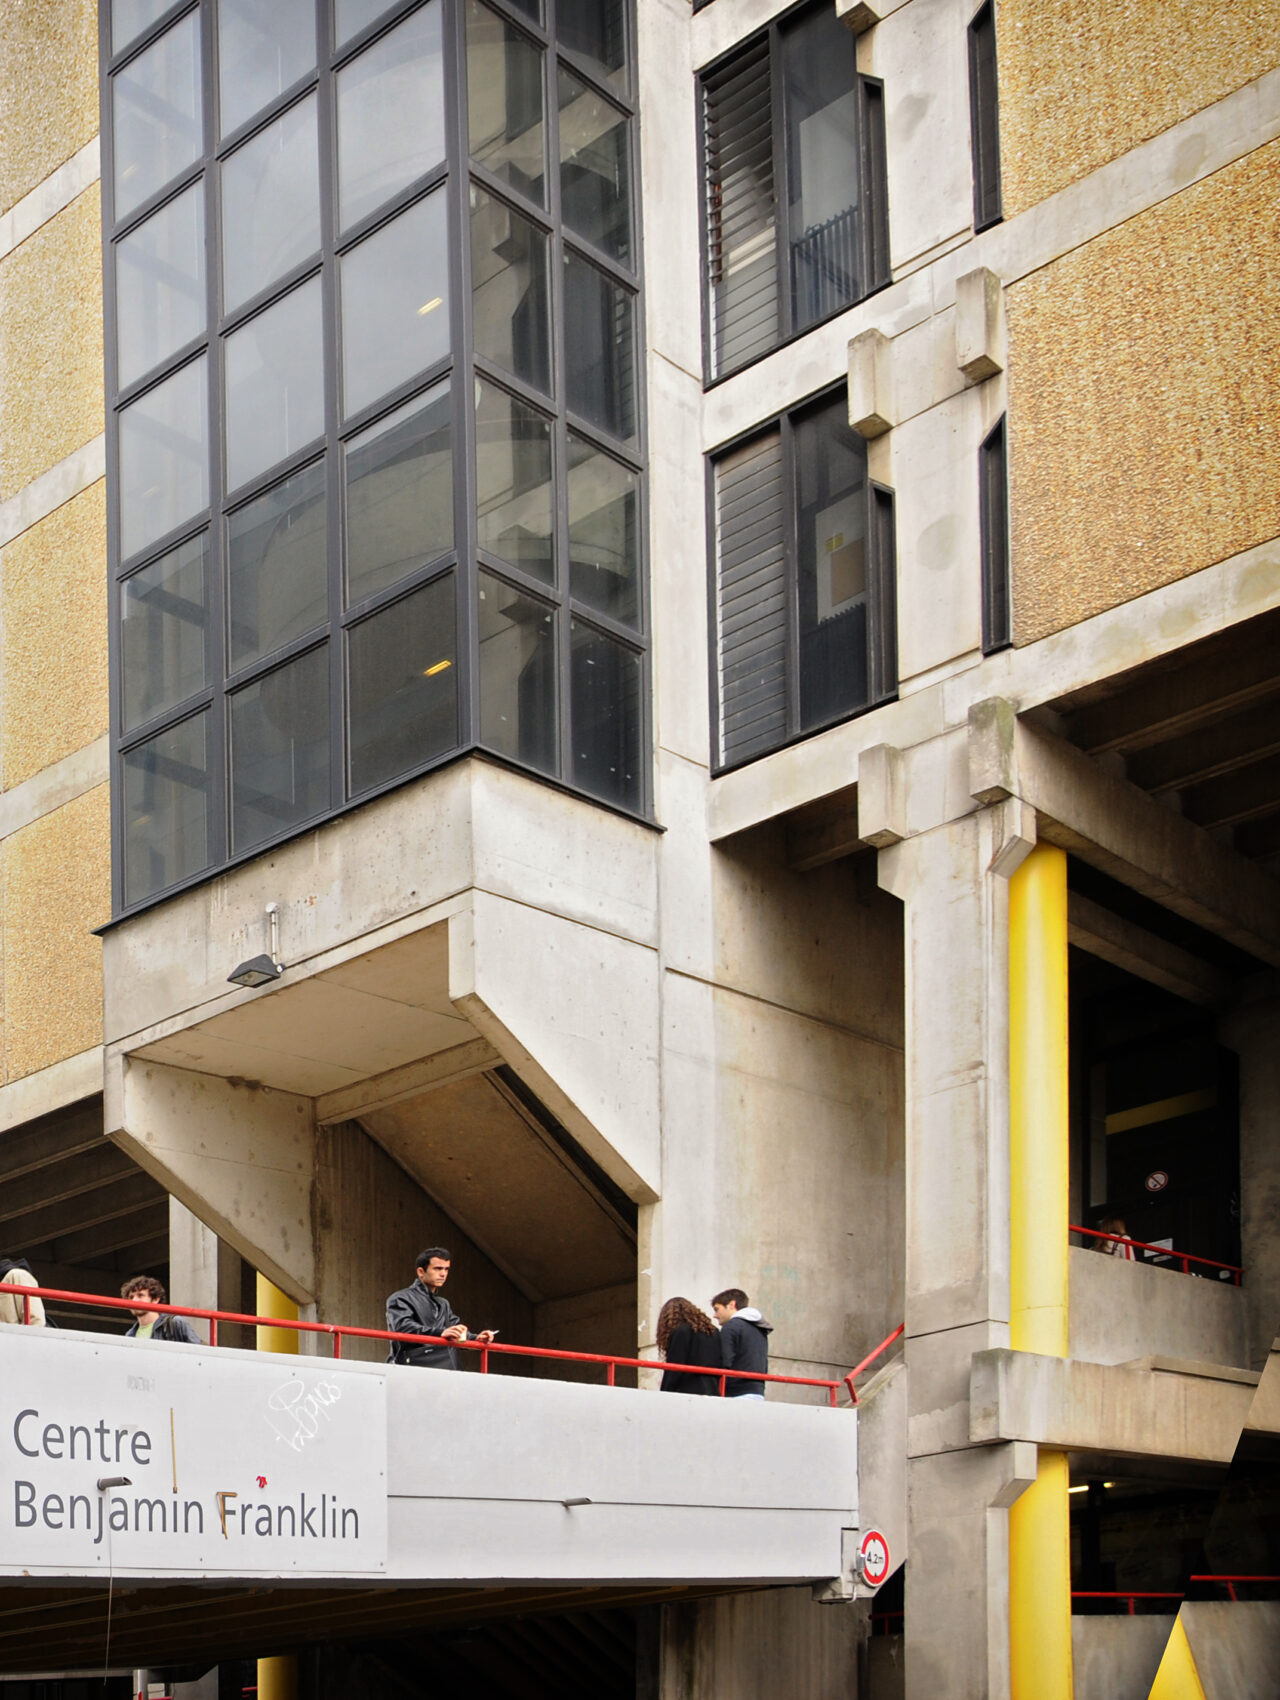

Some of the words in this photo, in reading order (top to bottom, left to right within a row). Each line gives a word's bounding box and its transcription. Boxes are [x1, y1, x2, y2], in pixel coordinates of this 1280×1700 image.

[13, 1409, 152, 1465] Centre
[14, 1480, 205, 1545] Benjamin
[220, 1491, 360, 1540] Franklin
